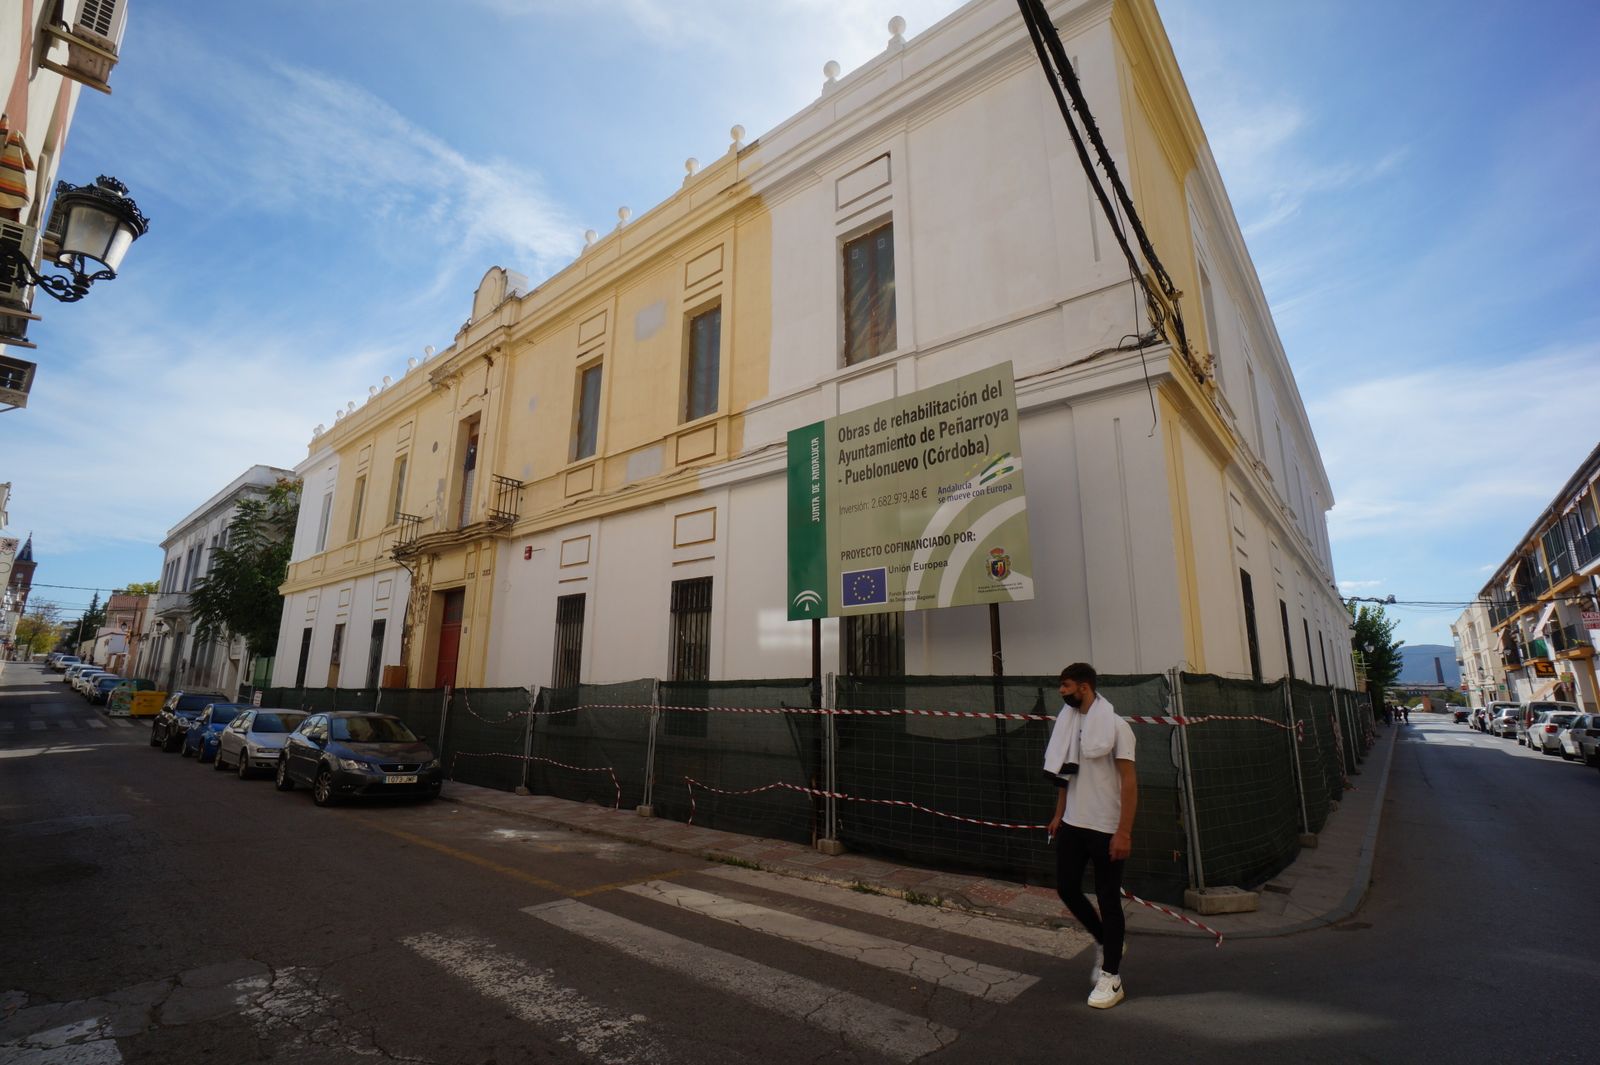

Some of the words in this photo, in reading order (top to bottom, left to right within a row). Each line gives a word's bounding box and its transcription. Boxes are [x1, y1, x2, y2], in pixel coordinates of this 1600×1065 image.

[838, 424, 870, 442] Obras
[874, 418, 887, 432] de
[891, 391, 978, 429] rehabilitación
[982, 381, 1002, 404] del
[839, 436, 916, 467] Ayuntamiento
[920, 427, 935, 443] de
[940, 407, 1009, 440] Peñarroya
[845, 456, 918, 485] Pueblonuevo
[923, 434, 990, 470] (Córdoba)
[813, 483, 819, 495] DE
[839, 500, 870, 516] Inversión:
[871, 489, 920, 510] 2.682.979,48
[921, 487, 927, 499] €
[938, 481, 972, 495] Andalucía
[938, 496, 945, 505] se
[947, 491, 970, 503] mueve
[972, 488, 985, 498] con
[986, 483, 1012, 497] Europa
[841, 546, 882, 561] PROYECTO
[884, 536, 951, 554] COFINANCIADO
[954, 532, 976, 544] POR:
[889, 563, 911, 575] Unión
[914, 559, 948, 572] Europea
